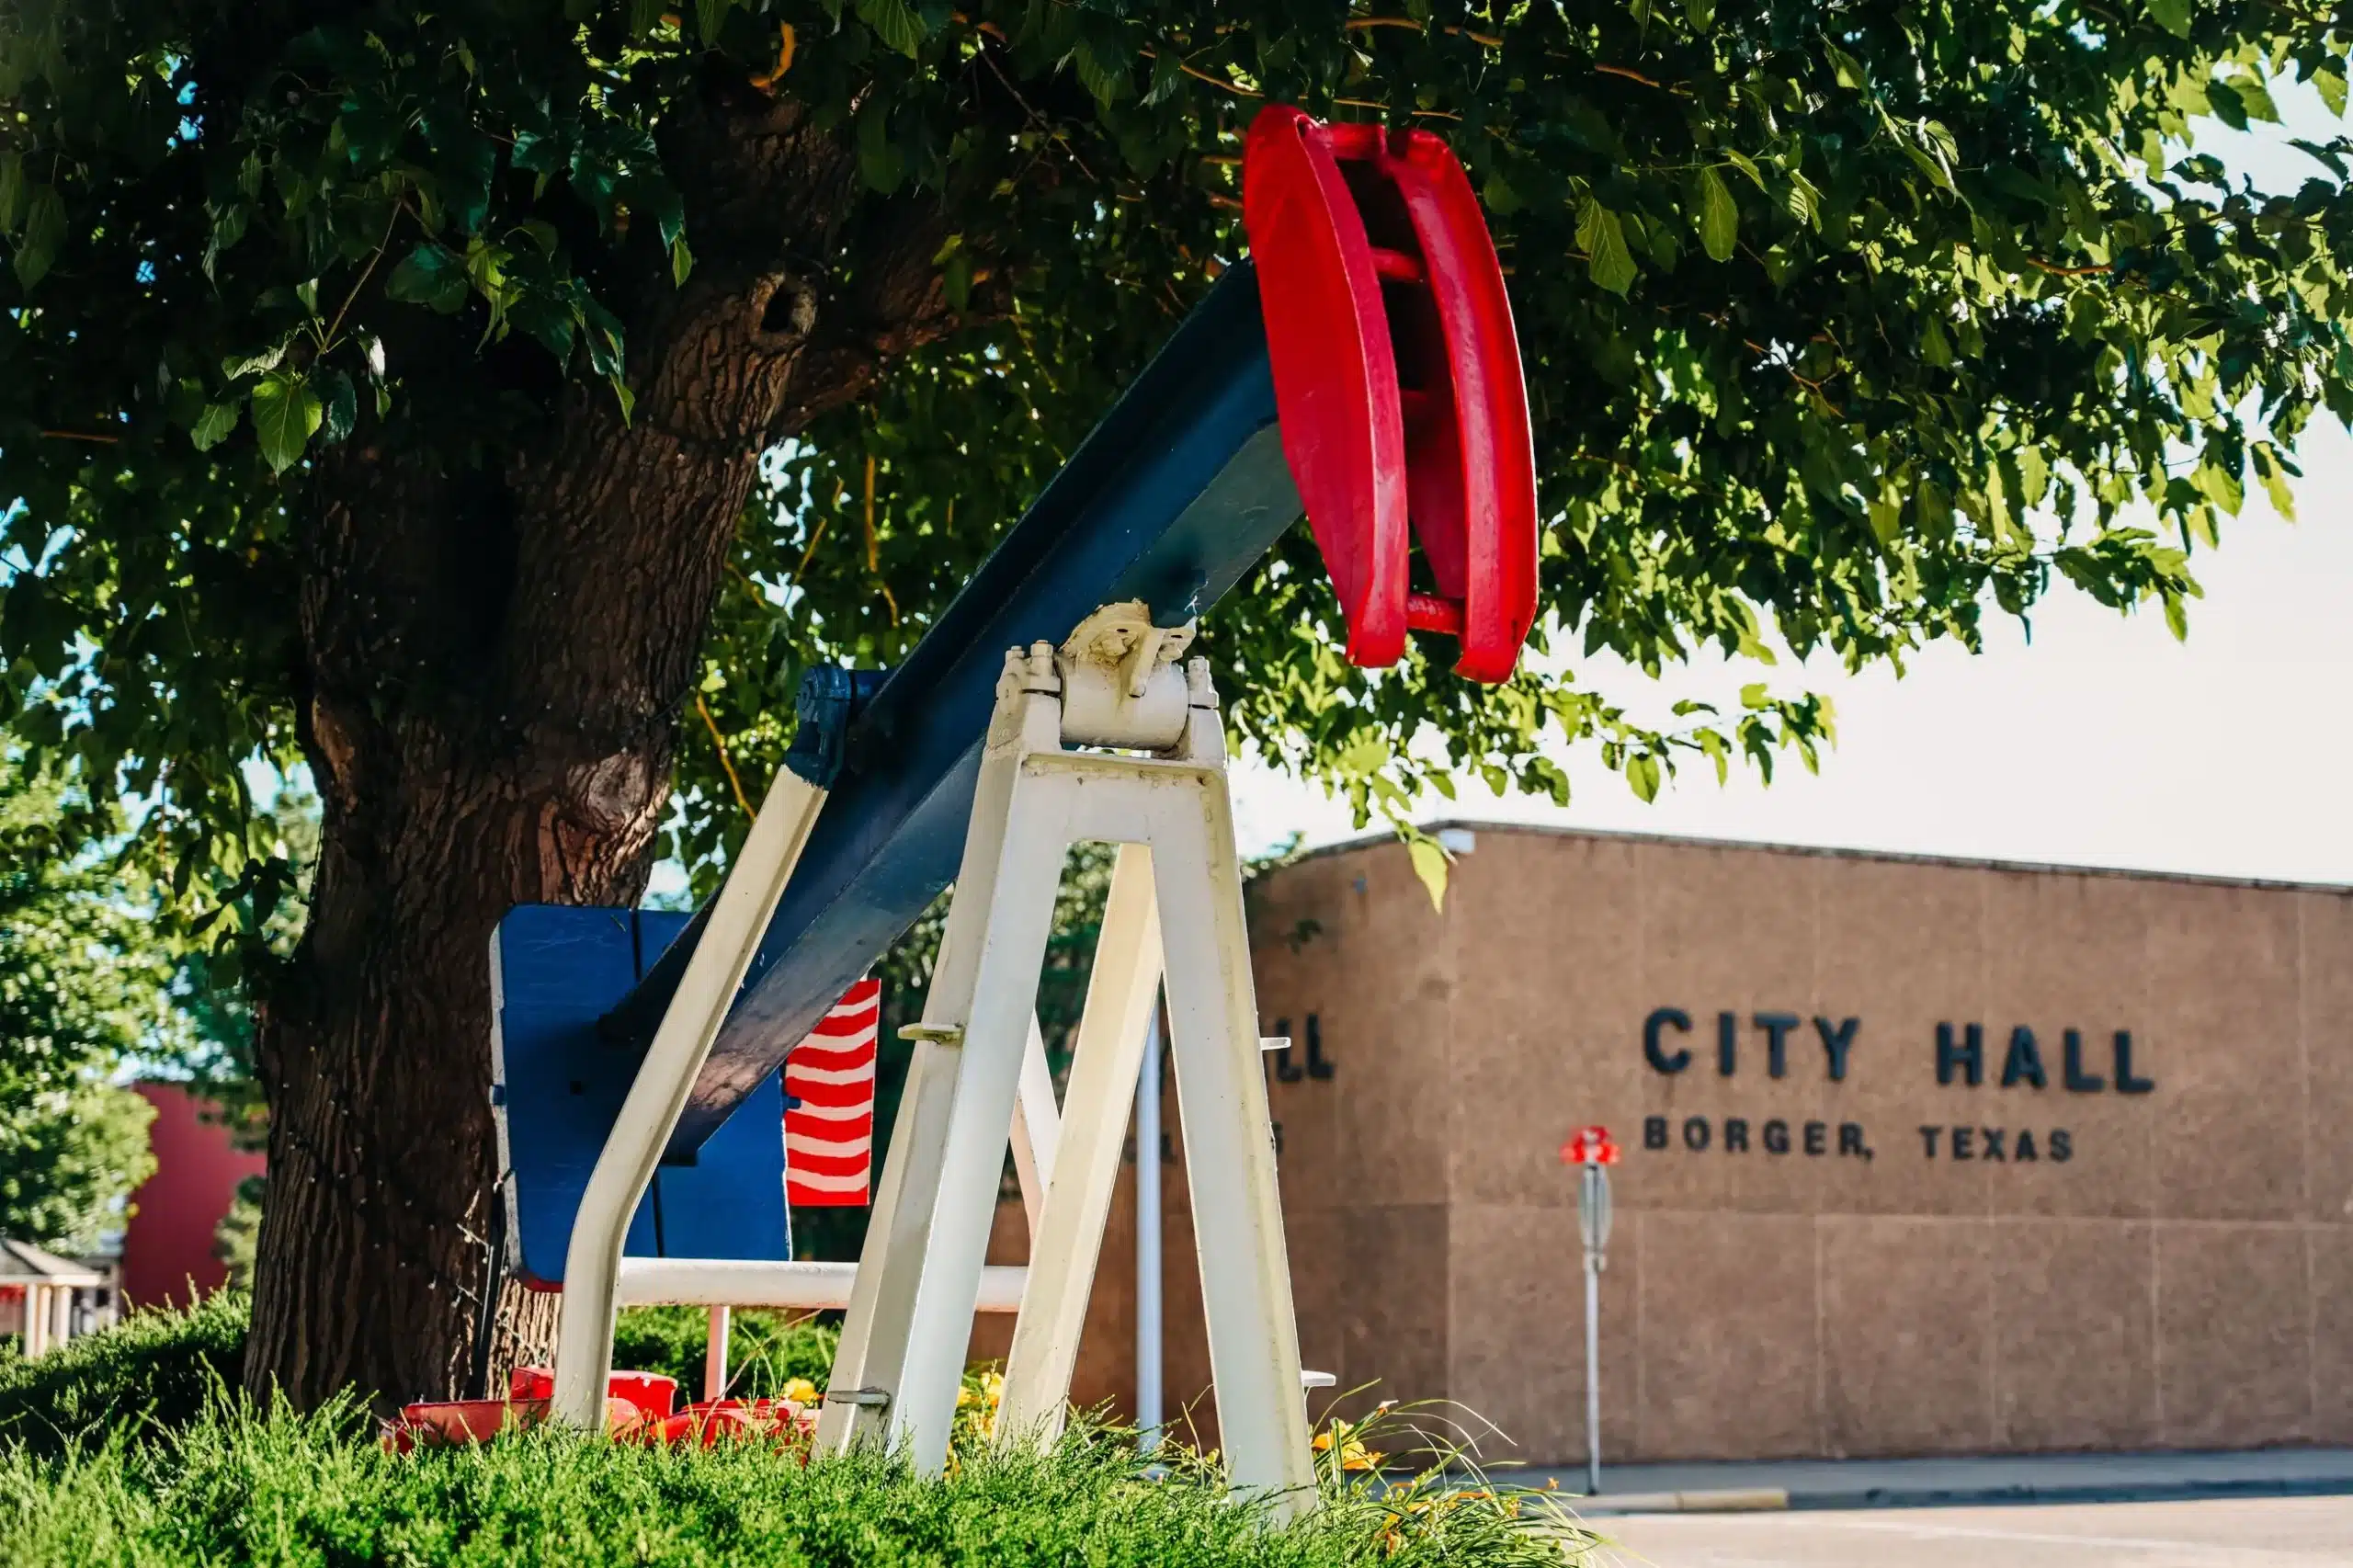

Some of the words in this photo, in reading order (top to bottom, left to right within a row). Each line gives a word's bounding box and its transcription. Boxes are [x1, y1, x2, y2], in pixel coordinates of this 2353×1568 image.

[1272, 1012, 1336, 1083] LL
[1643, 1007, 1860, 1081] CITY
[1935, 1021, 2155, 1094] HALL
[1643, 1116, 1874, 1162] BORGER,
[1918, 1124, 2073, 1162] TEXAS
